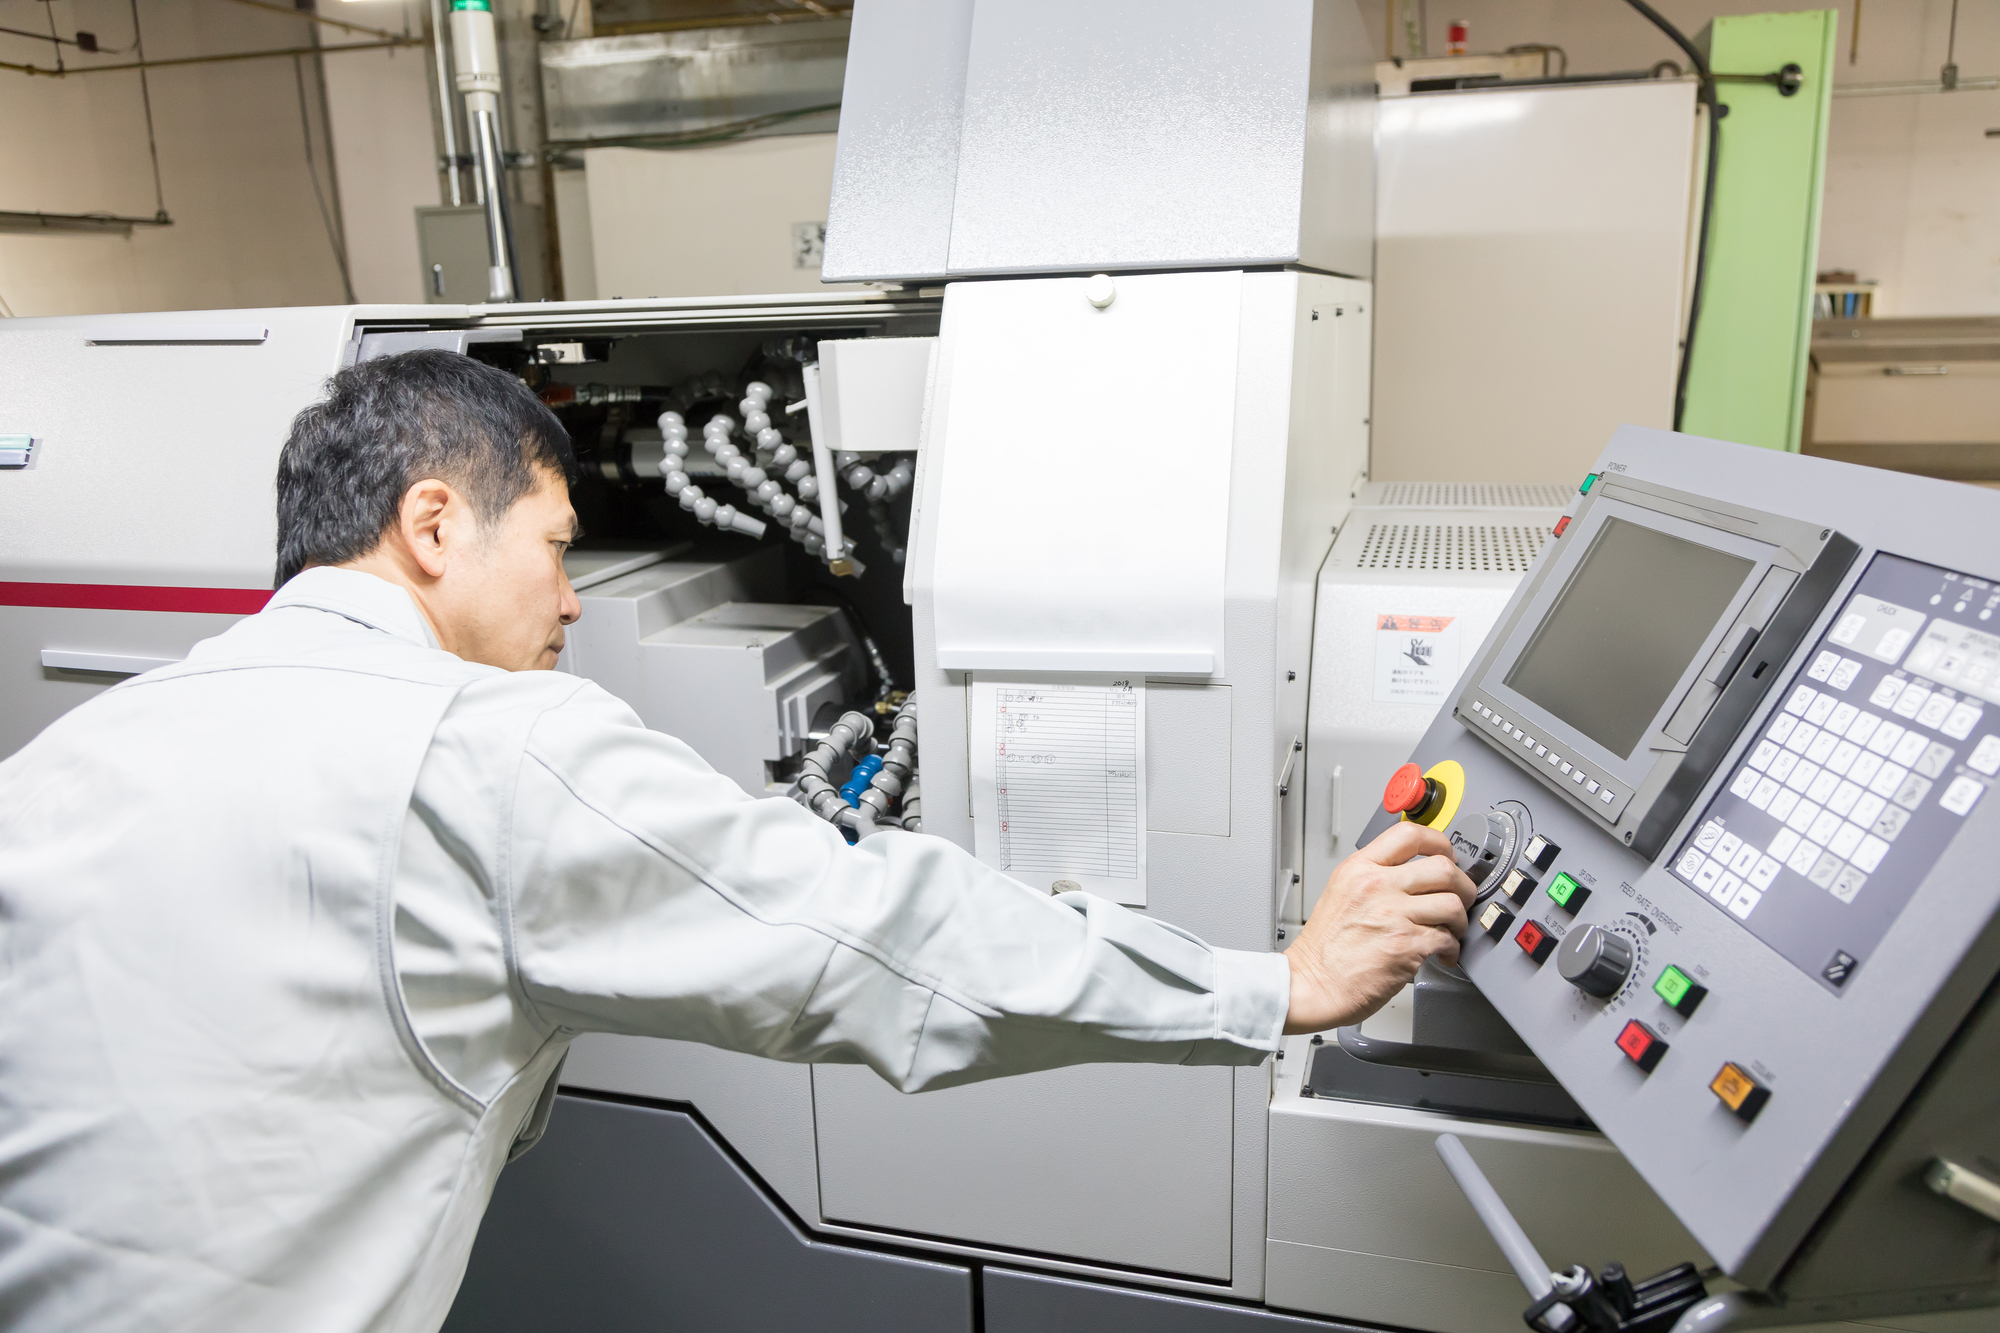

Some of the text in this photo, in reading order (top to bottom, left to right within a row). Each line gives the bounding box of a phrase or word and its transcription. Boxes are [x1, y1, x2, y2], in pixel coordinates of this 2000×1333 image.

[1606, 461, 1628, 473] POWER
[1818, 700, 1828, 710] N
[1839, 710, 1848, 720] G
[1779, 719, 1789, 730] X
[1799, 729, 1809, 739] Z
[1819, 738, 1829, 748] F
[1780, 757, 1789, 767] S
[1801, 767, 1810, 776] T
[1743, 774, 1753, 784] U
[1761, 784, 1772, 795] W
[1842, 790, 1851, 799] 2
[1618, 881, 1684, 936] FEED RATE OVERRIDE
[1544, 914, 1552, 925] ALL
